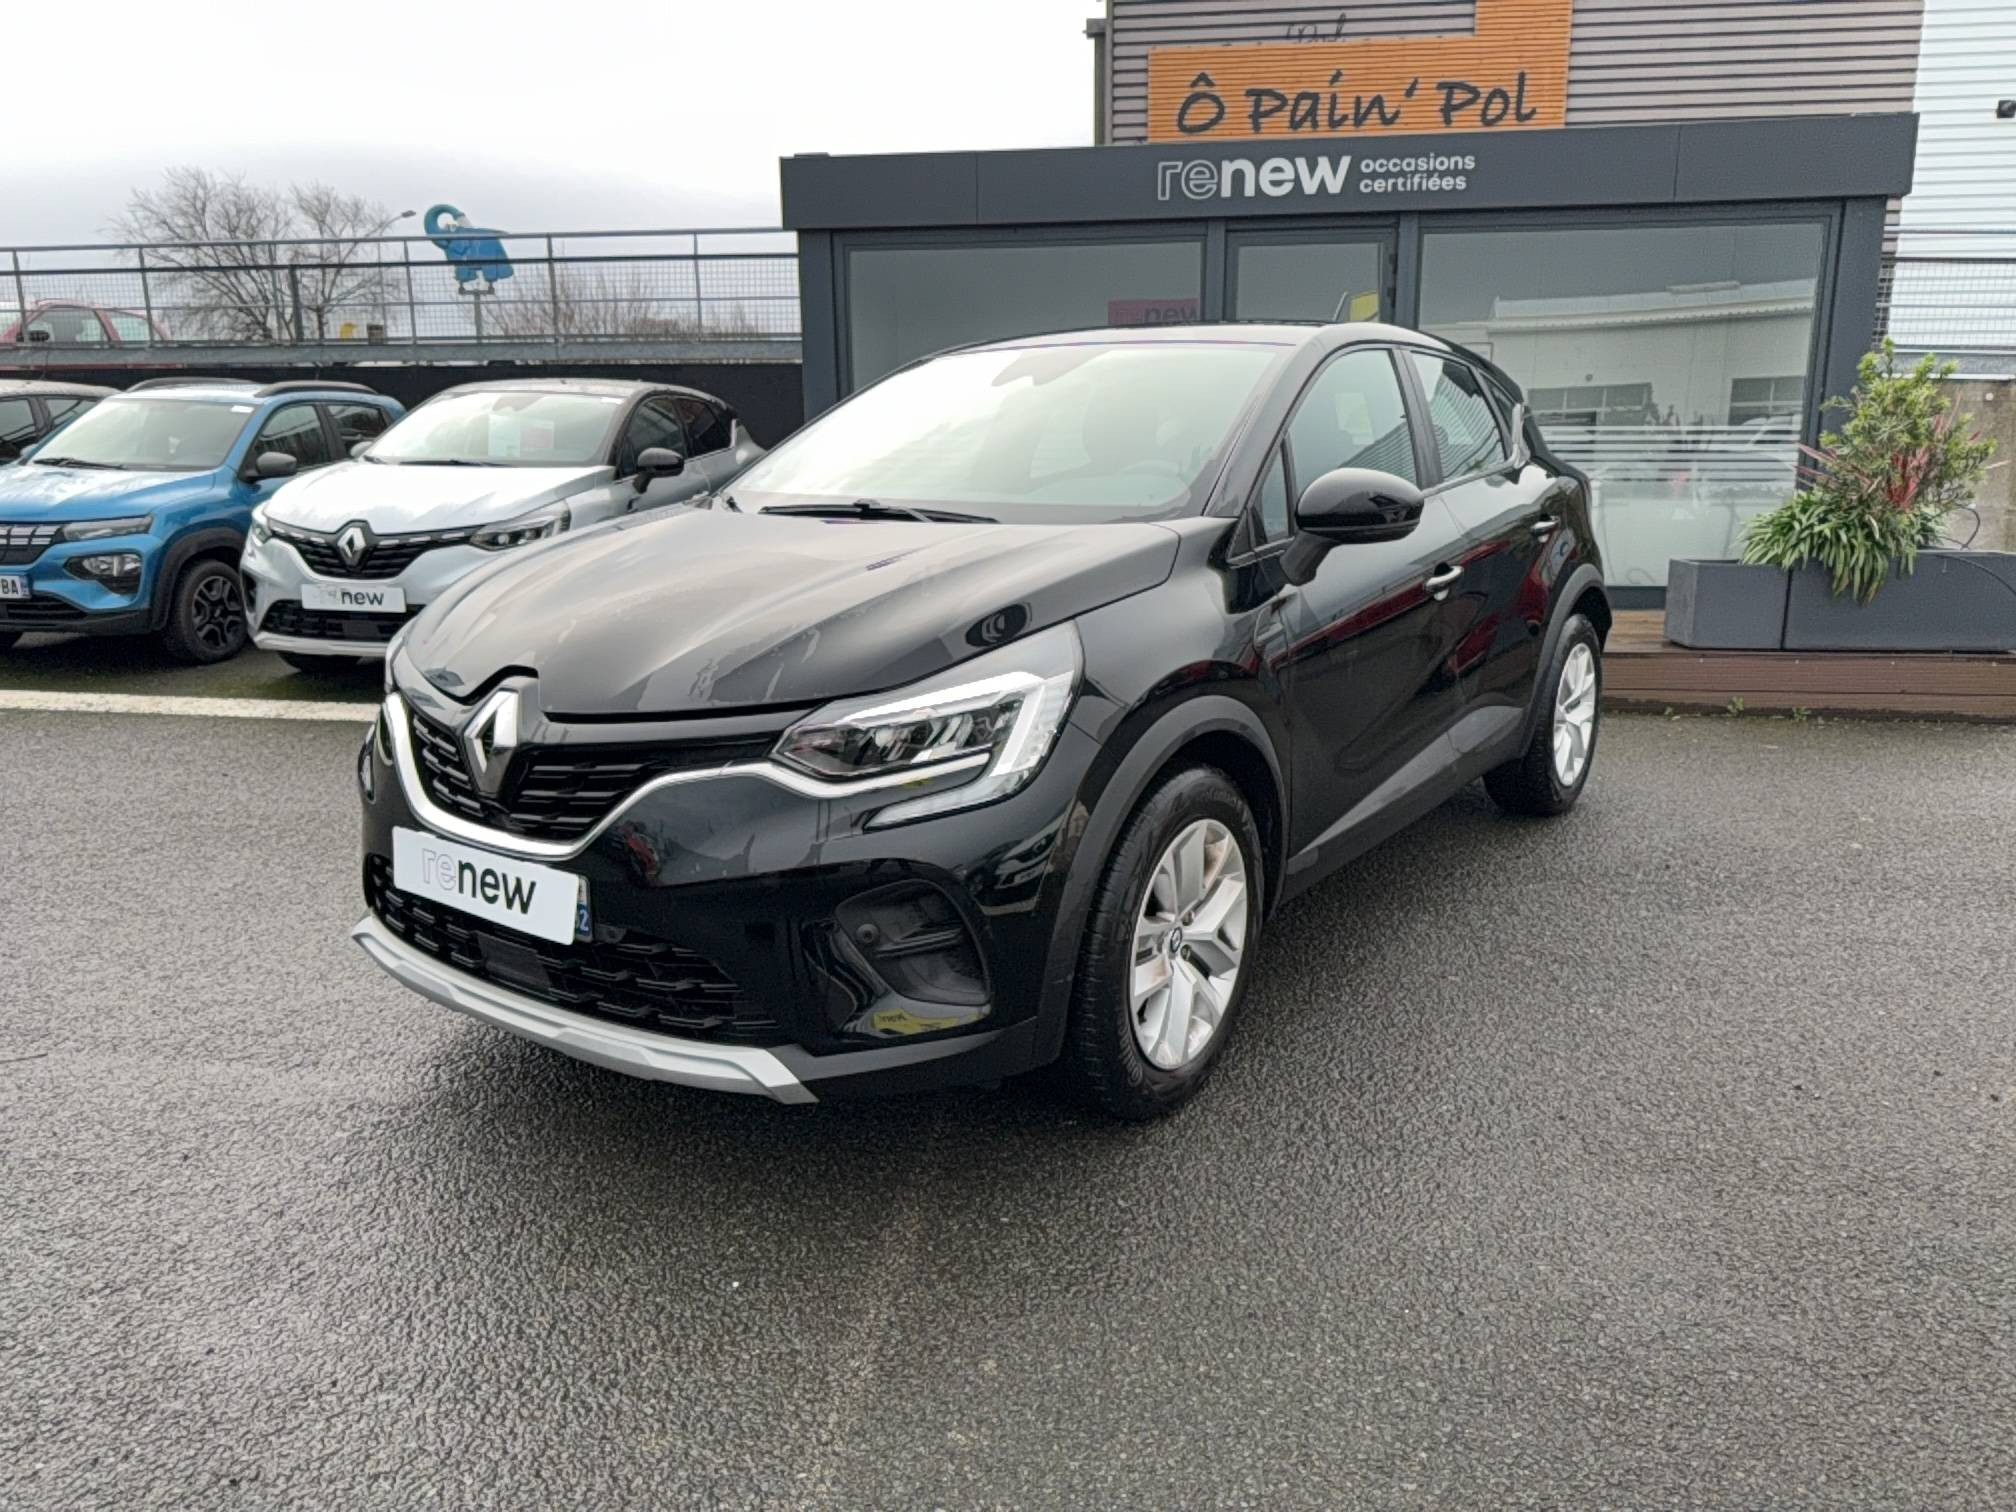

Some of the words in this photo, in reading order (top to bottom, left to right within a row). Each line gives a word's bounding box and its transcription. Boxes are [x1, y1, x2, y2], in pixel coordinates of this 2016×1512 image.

[1177, 72, 1225, 134] Ô
[1436, 71, 1537, 127] Pol
[1157, 154, 1352, 201] renew
[1359, 172, 1467, 193] certifiées
[1360, 152, 1476, 173] occasions
[422, 848, 536, 914] renew
